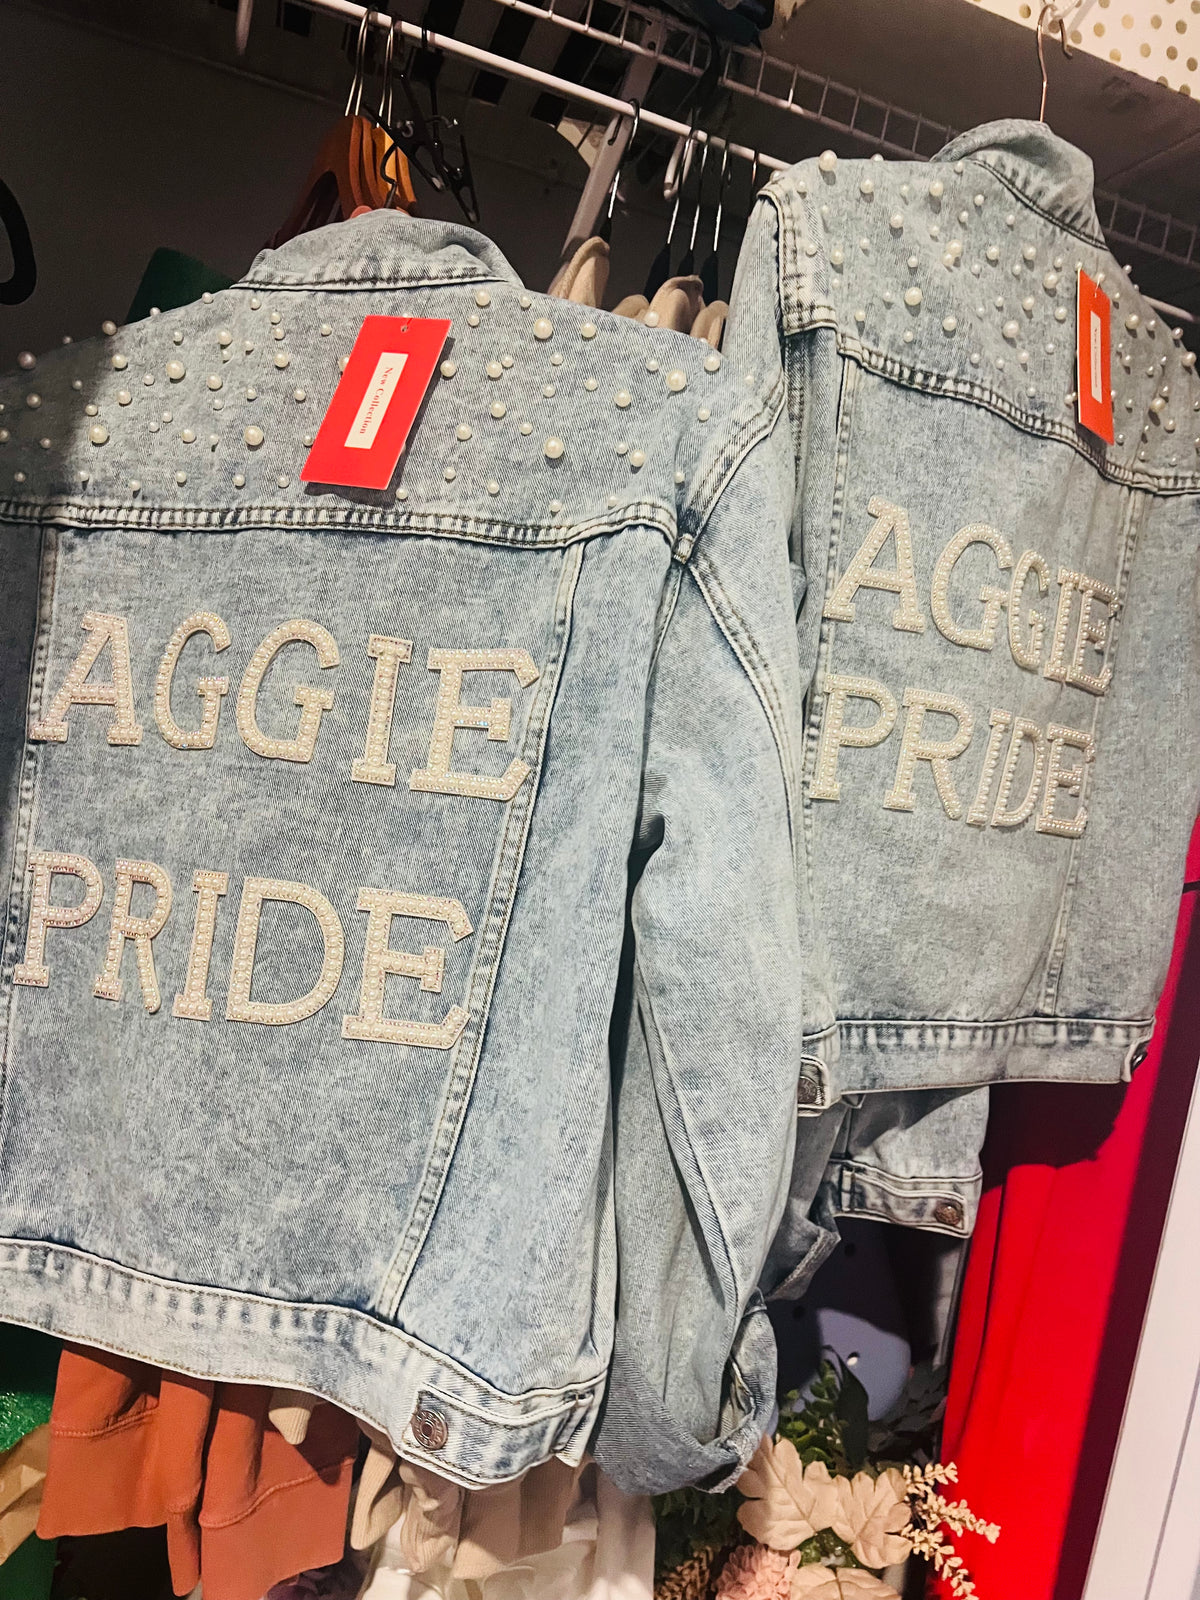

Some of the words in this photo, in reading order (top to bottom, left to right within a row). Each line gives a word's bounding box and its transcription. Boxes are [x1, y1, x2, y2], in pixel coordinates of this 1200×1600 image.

[359, 388, 385, 434] Collection
[380, 367, 394, 385] New
[822, 496, 1123, 696] AGGIE
[29, 611, 540, 800] AGGIE
[809, 673, 1095, 839] PRIDE
[13, 851, 474, 1050] PRIDE
